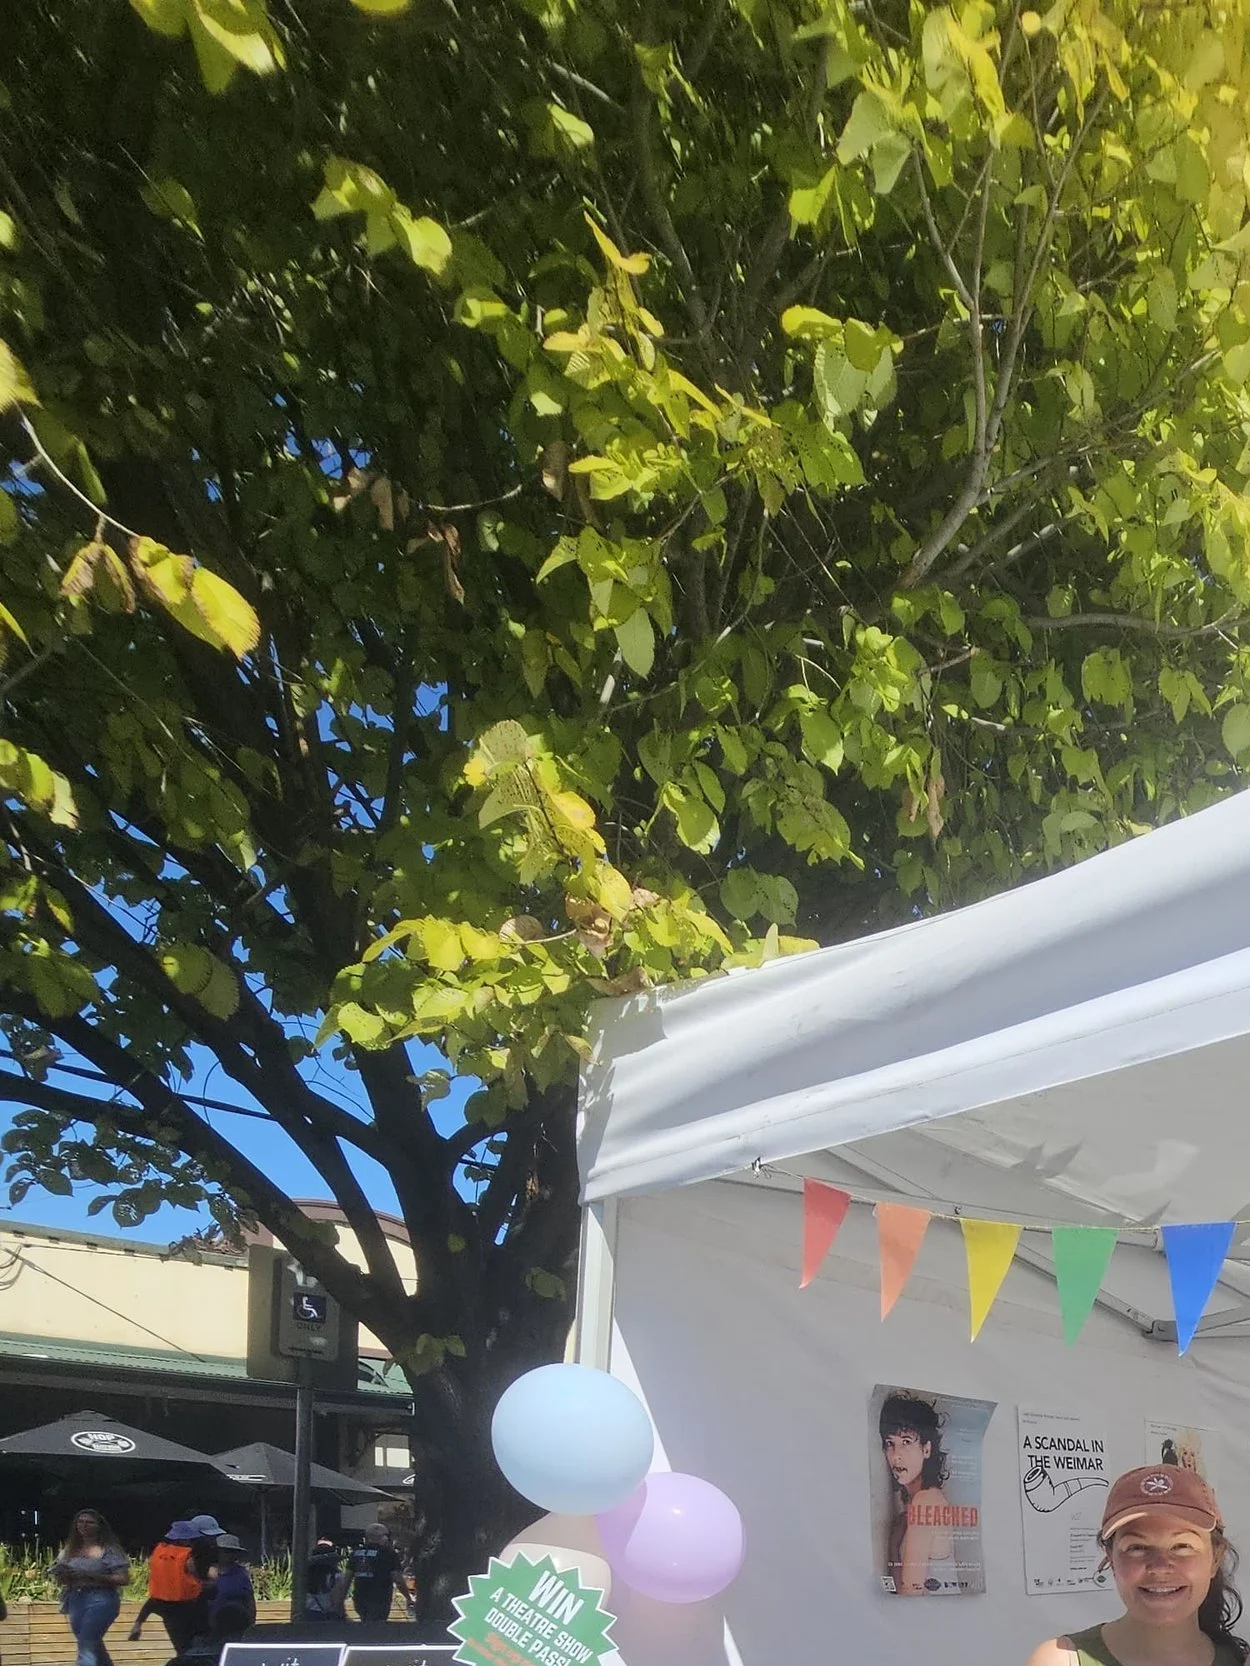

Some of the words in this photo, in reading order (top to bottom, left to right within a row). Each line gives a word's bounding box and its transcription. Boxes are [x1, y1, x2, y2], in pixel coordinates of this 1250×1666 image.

[1022, 1435, 1033, 1449] A
[1034, 1436, 1090, 1453] SCANDAL
[1091, 1439, 1105, 1453] IN
[1027, 1454, 1051, 1469] THE
[1053, 1456, 1104, 1471] WEIMAR
[907, 1503, 979, 1528] BLEACHED
[528, 1570, 584, 1625] WIN
[484, 1607, 533, 1648] DOUBLE
[489, 1587, 504, 1603] A
[501, 1593, 558, 1639] THEATRE
[554, 1631, 593, 1664] SHOW
